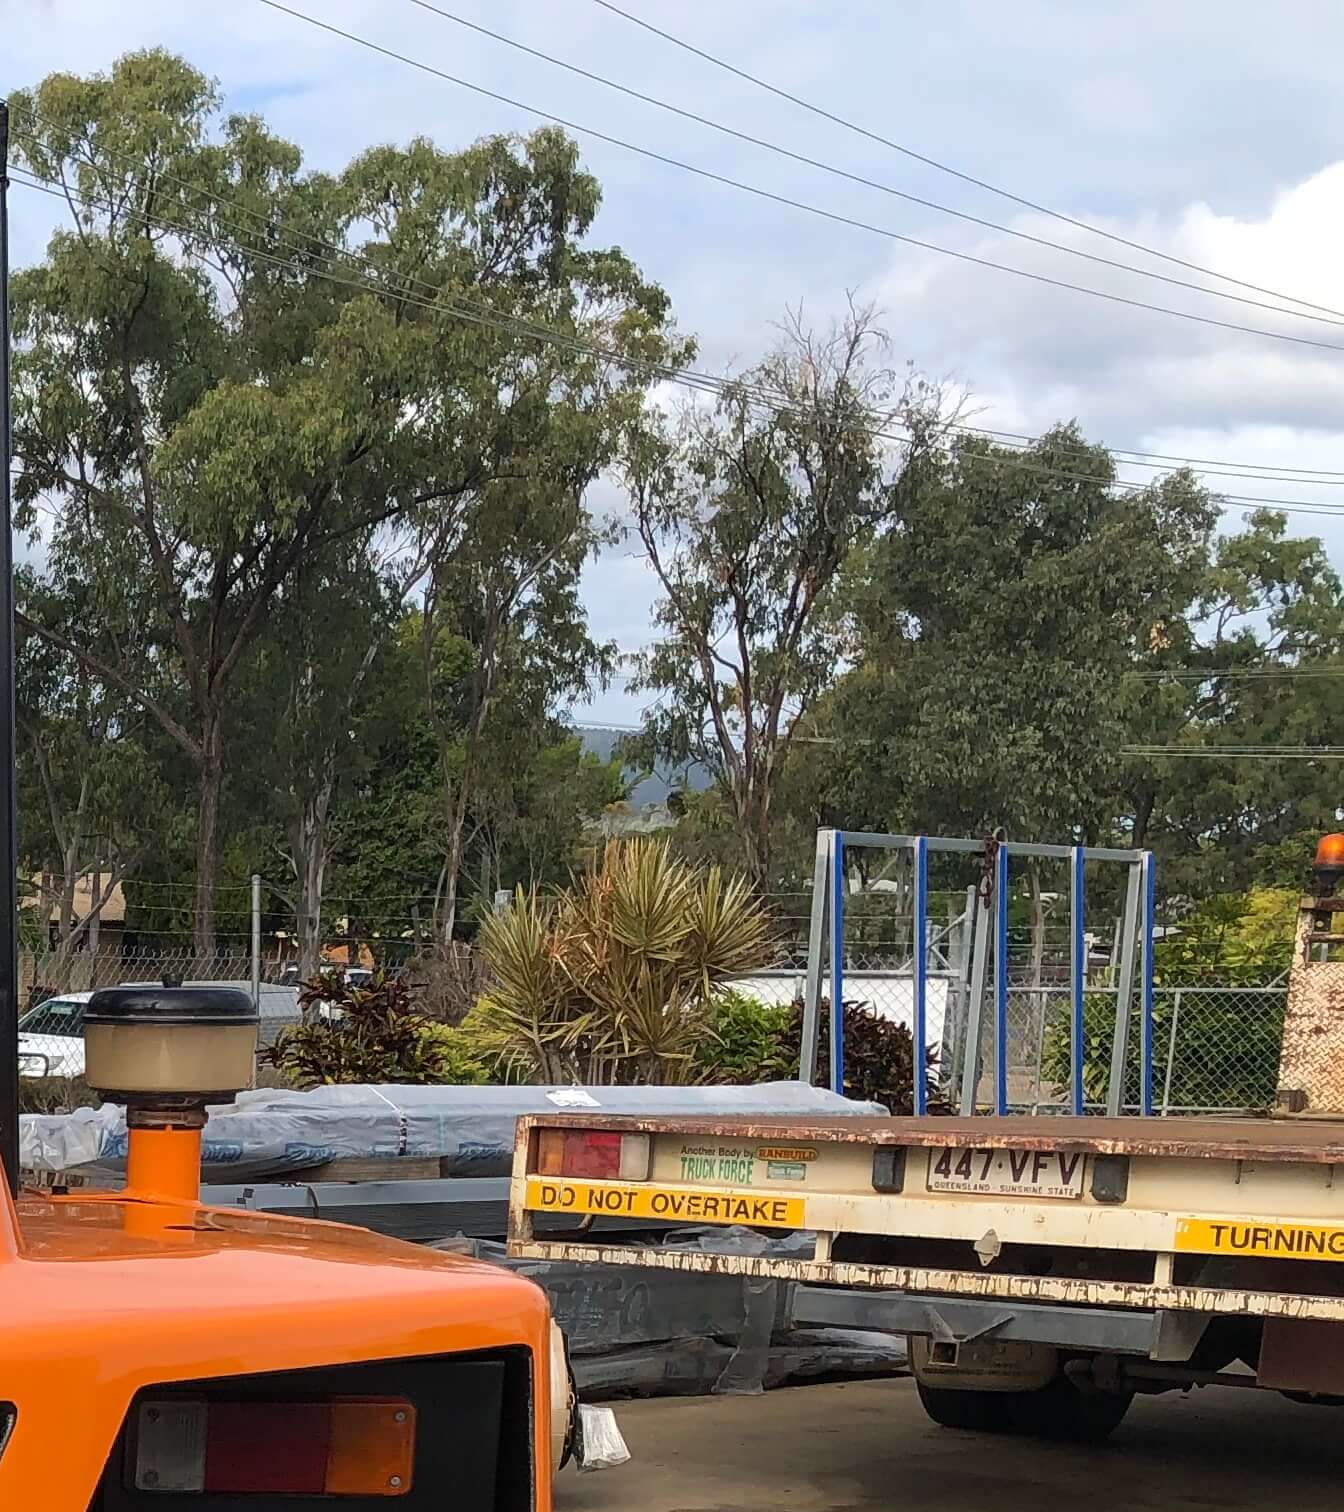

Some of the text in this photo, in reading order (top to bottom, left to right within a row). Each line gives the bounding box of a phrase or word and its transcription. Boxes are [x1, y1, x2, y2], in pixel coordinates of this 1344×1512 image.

[680, 1144, 754, 1160] Another Body by
[680, 1156, 717, 1181] TRUCK
[717, 1159, 754, 1185] FORCE
[934, 1181, 1075, 1197] QUEENSLAND SUNSHINE STATE
[542, 1186, 788, 1222] DO NOT OVERTAKE
[1210, 1224, 1344, 1255] TURNING
